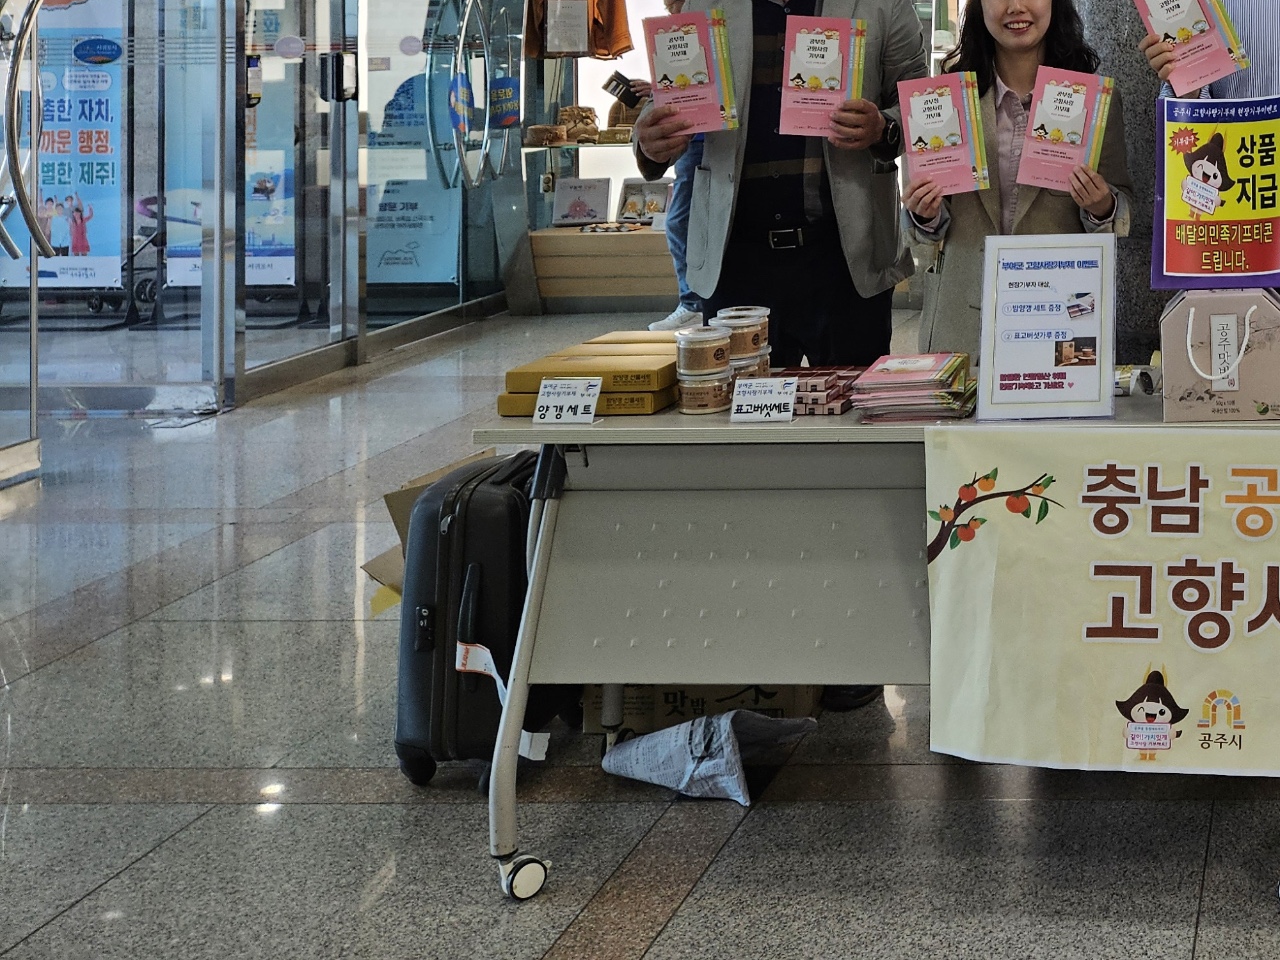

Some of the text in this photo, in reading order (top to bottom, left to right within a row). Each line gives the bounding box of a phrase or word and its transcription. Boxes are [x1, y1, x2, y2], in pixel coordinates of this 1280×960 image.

[27, 98, 114, 123] 촘한 자치,
[1173, 108, 1191, 117] 공주시
[41, 130, 114, 154] 까운 행정,
[1236, 133, 1277, 168] 상품
[41, 162, 115, 185] 별한 제주!
[1236, 173, 1278, 211] 지급
[1175, 222, 1273, 246] 배달의민족기프티콘
[1002, 259, 1099, 271] 부여군 고향사랑기부제 이벤트
[1201, 250, 1249, 272] 드립니다.
[1033, 304, 1046, 312] 세트
[1048, 304, 1061, 312] 증정
[1054, 331, 1067, 339] 증정
[1217, 323, 1232, 381] 공주맛밤
[734, 403, 791, 418] 표고버섯세트
[1081, 463, 1209, 535] 충남
[1198, 732, 1243, 751] 공주시
